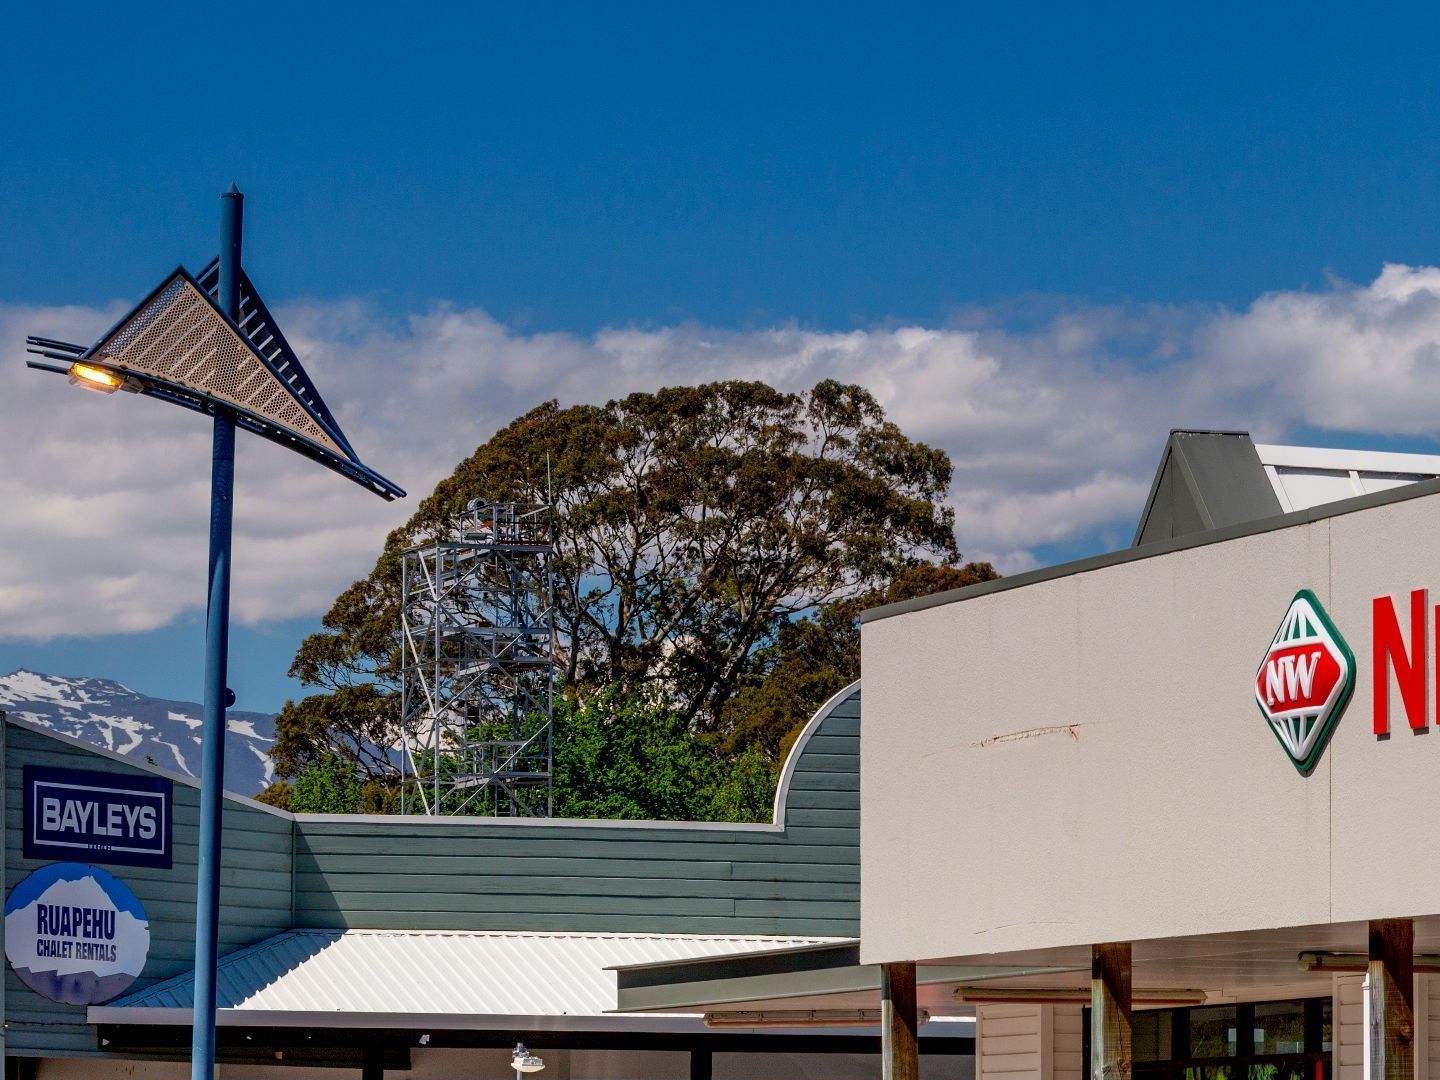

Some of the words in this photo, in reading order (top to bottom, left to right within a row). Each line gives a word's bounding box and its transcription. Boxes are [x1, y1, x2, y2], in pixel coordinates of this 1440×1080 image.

[1265, 652, 1321, 706] NW
[42, 797, 157, 840] BAYLEYS
[36, 904, 116, 940] RUAPEHU
[36, 938, 73, 959] CHALET
[75, 942, 117, 962] RENTALS
